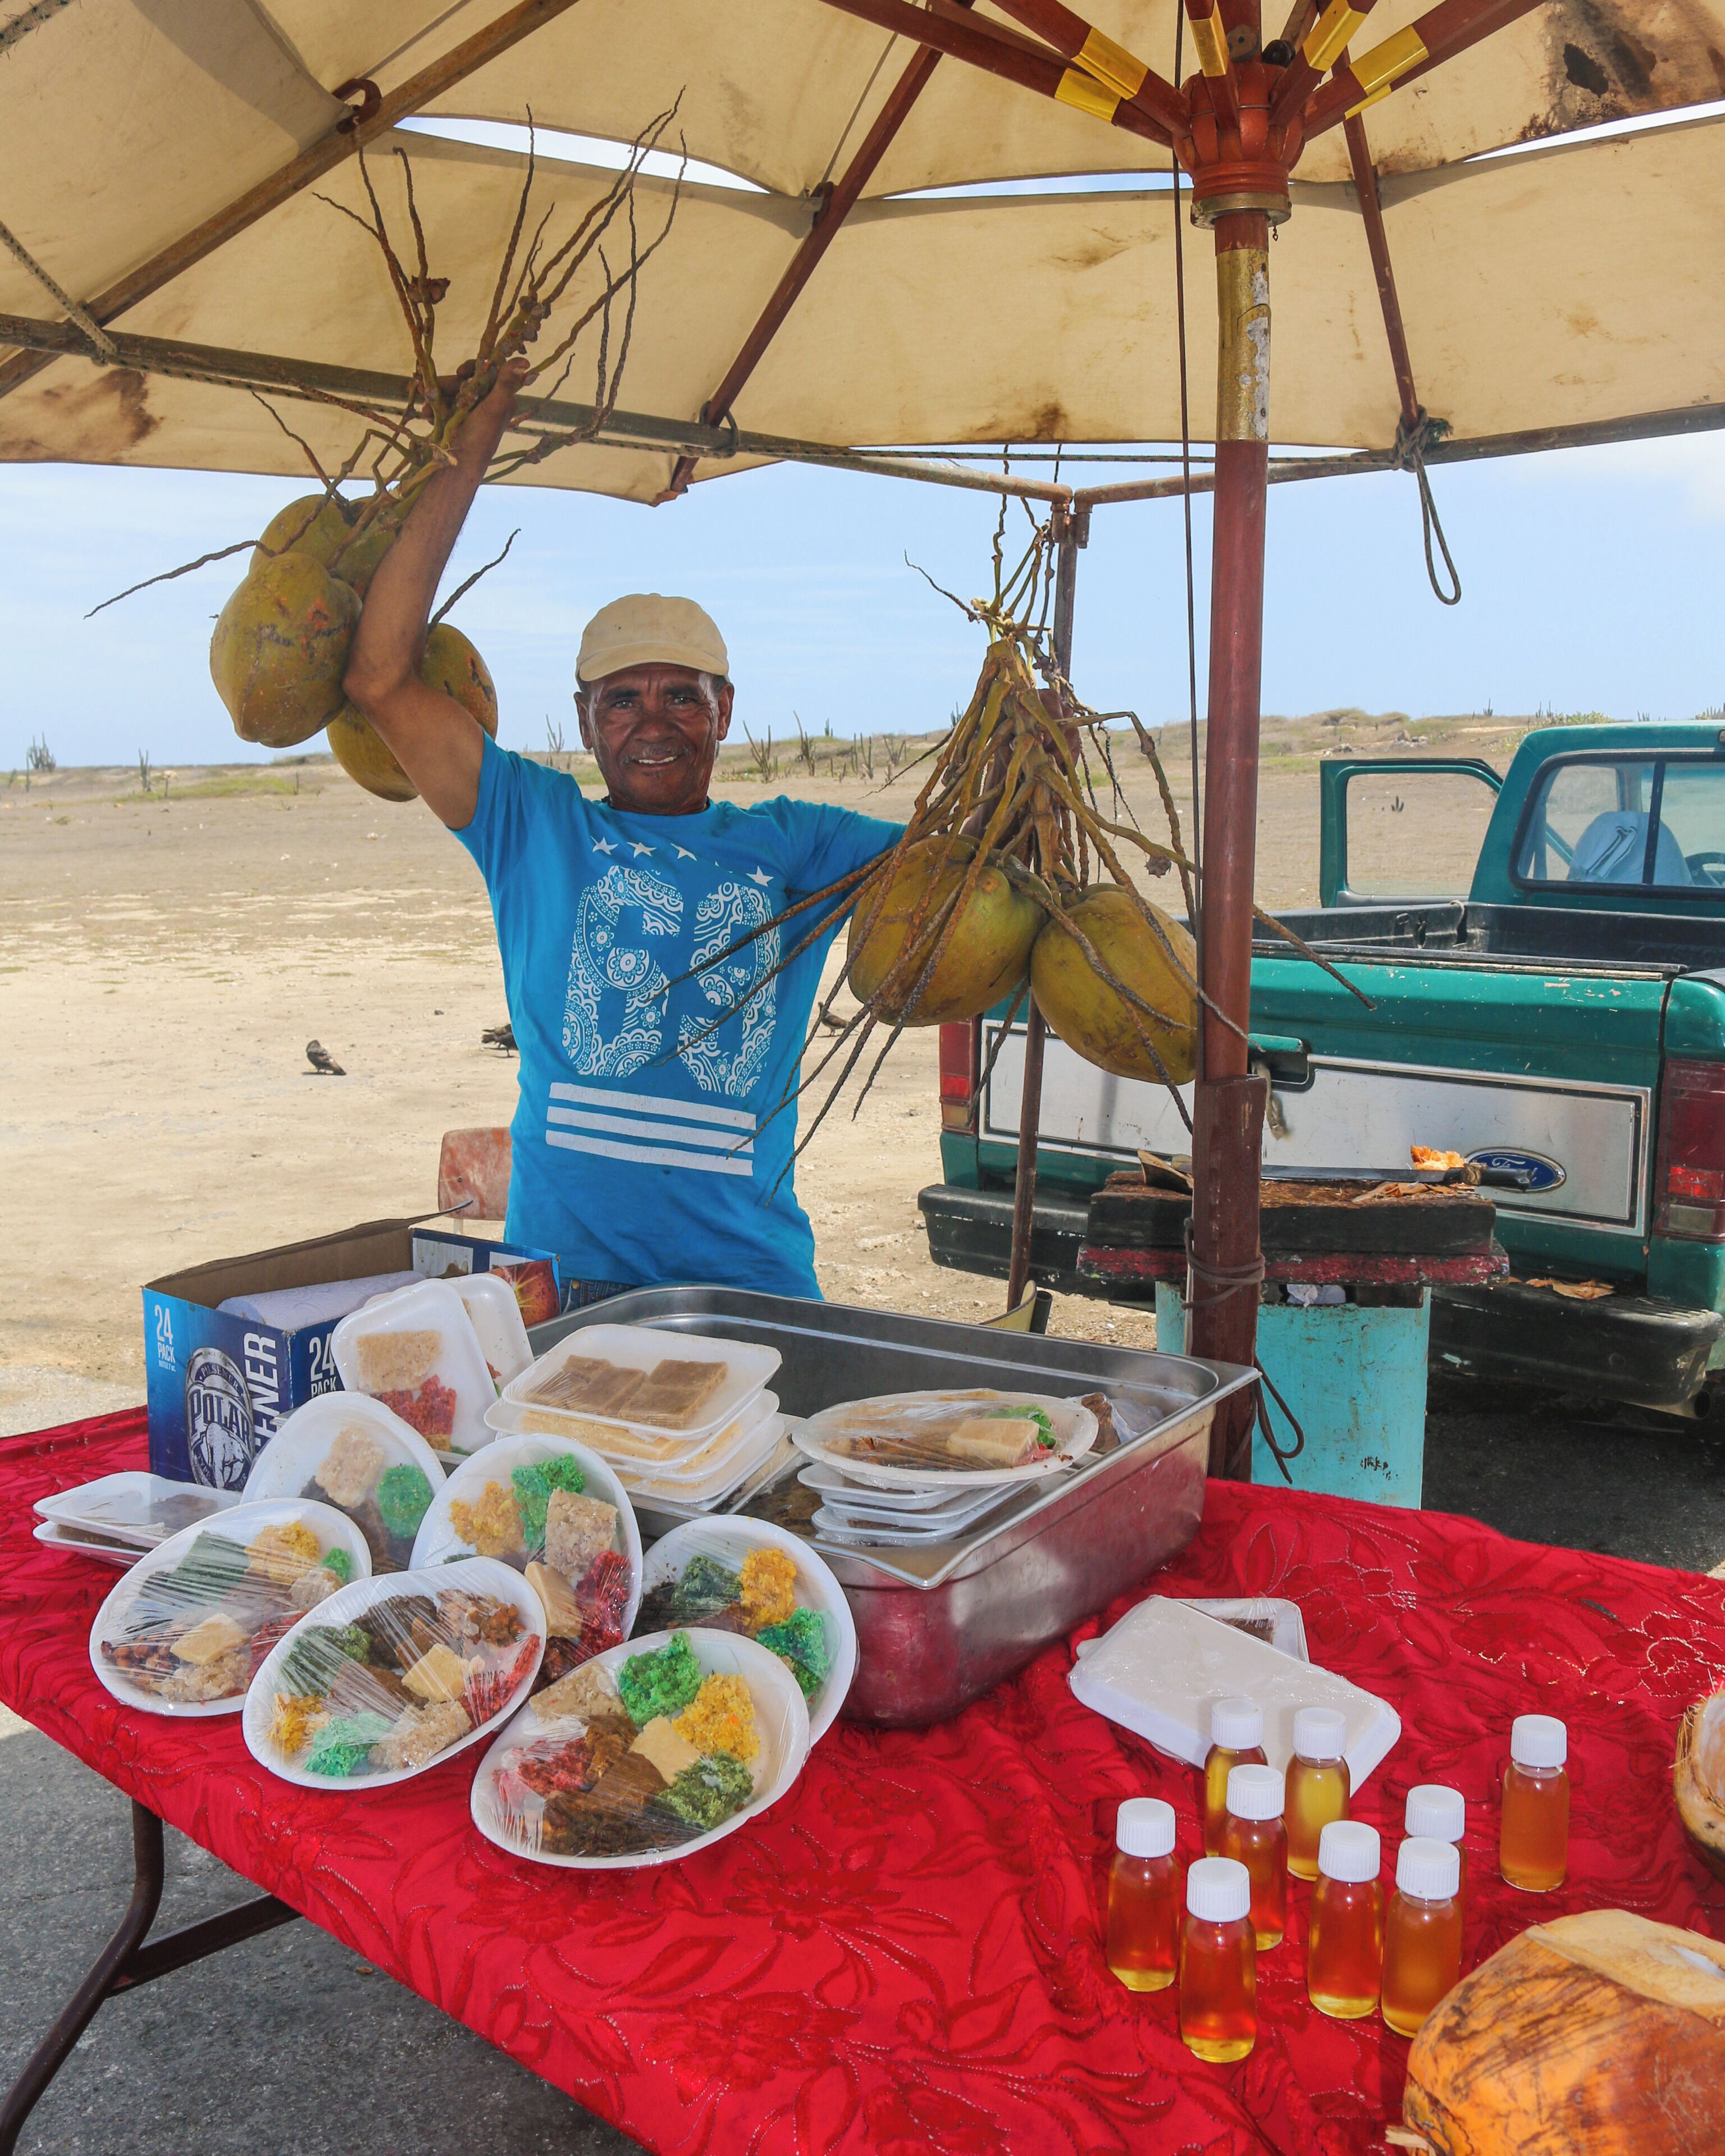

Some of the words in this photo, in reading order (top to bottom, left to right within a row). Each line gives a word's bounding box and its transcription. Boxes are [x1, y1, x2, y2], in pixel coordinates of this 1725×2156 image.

[154, 1304, 173, 1345] 24
[158, 1341, 176, 1364] PACK
[309, 1332, 337, 1382] 24
[201, 1365, 239, 1390] PILSENER
[244, 1332, 279, 1447] ENER
[189, 1389, 252, 1451] POLAR
